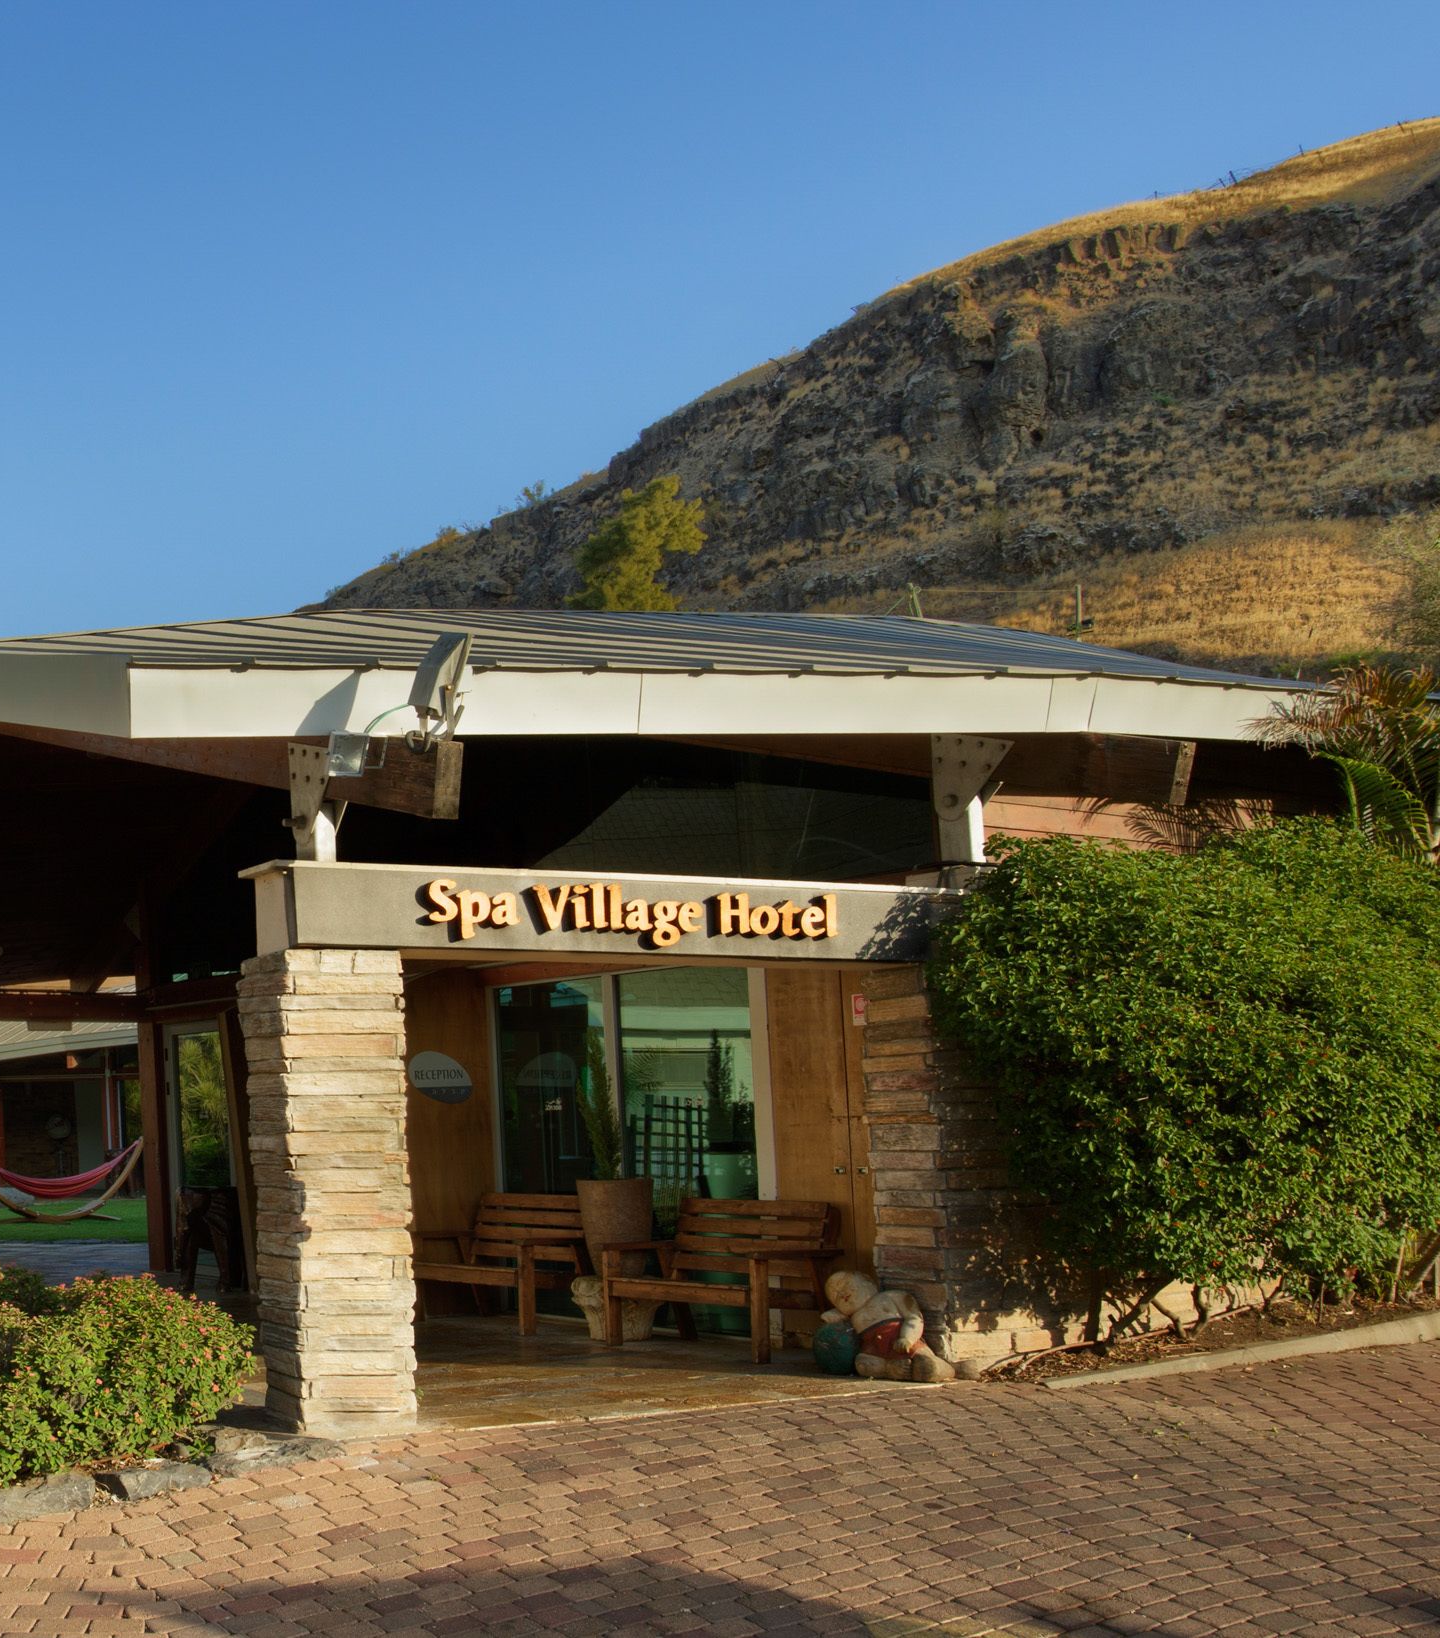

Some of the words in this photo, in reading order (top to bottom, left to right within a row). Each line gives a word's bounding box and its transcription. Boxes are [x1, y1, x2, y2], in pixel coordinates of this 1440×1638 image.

[427, 878, 521, 940] Spa
[531, 882, 704, 948] Village
[715, 891, 840, 939] Hotel
[414, 1069, 464, 1081] RECEPTION
